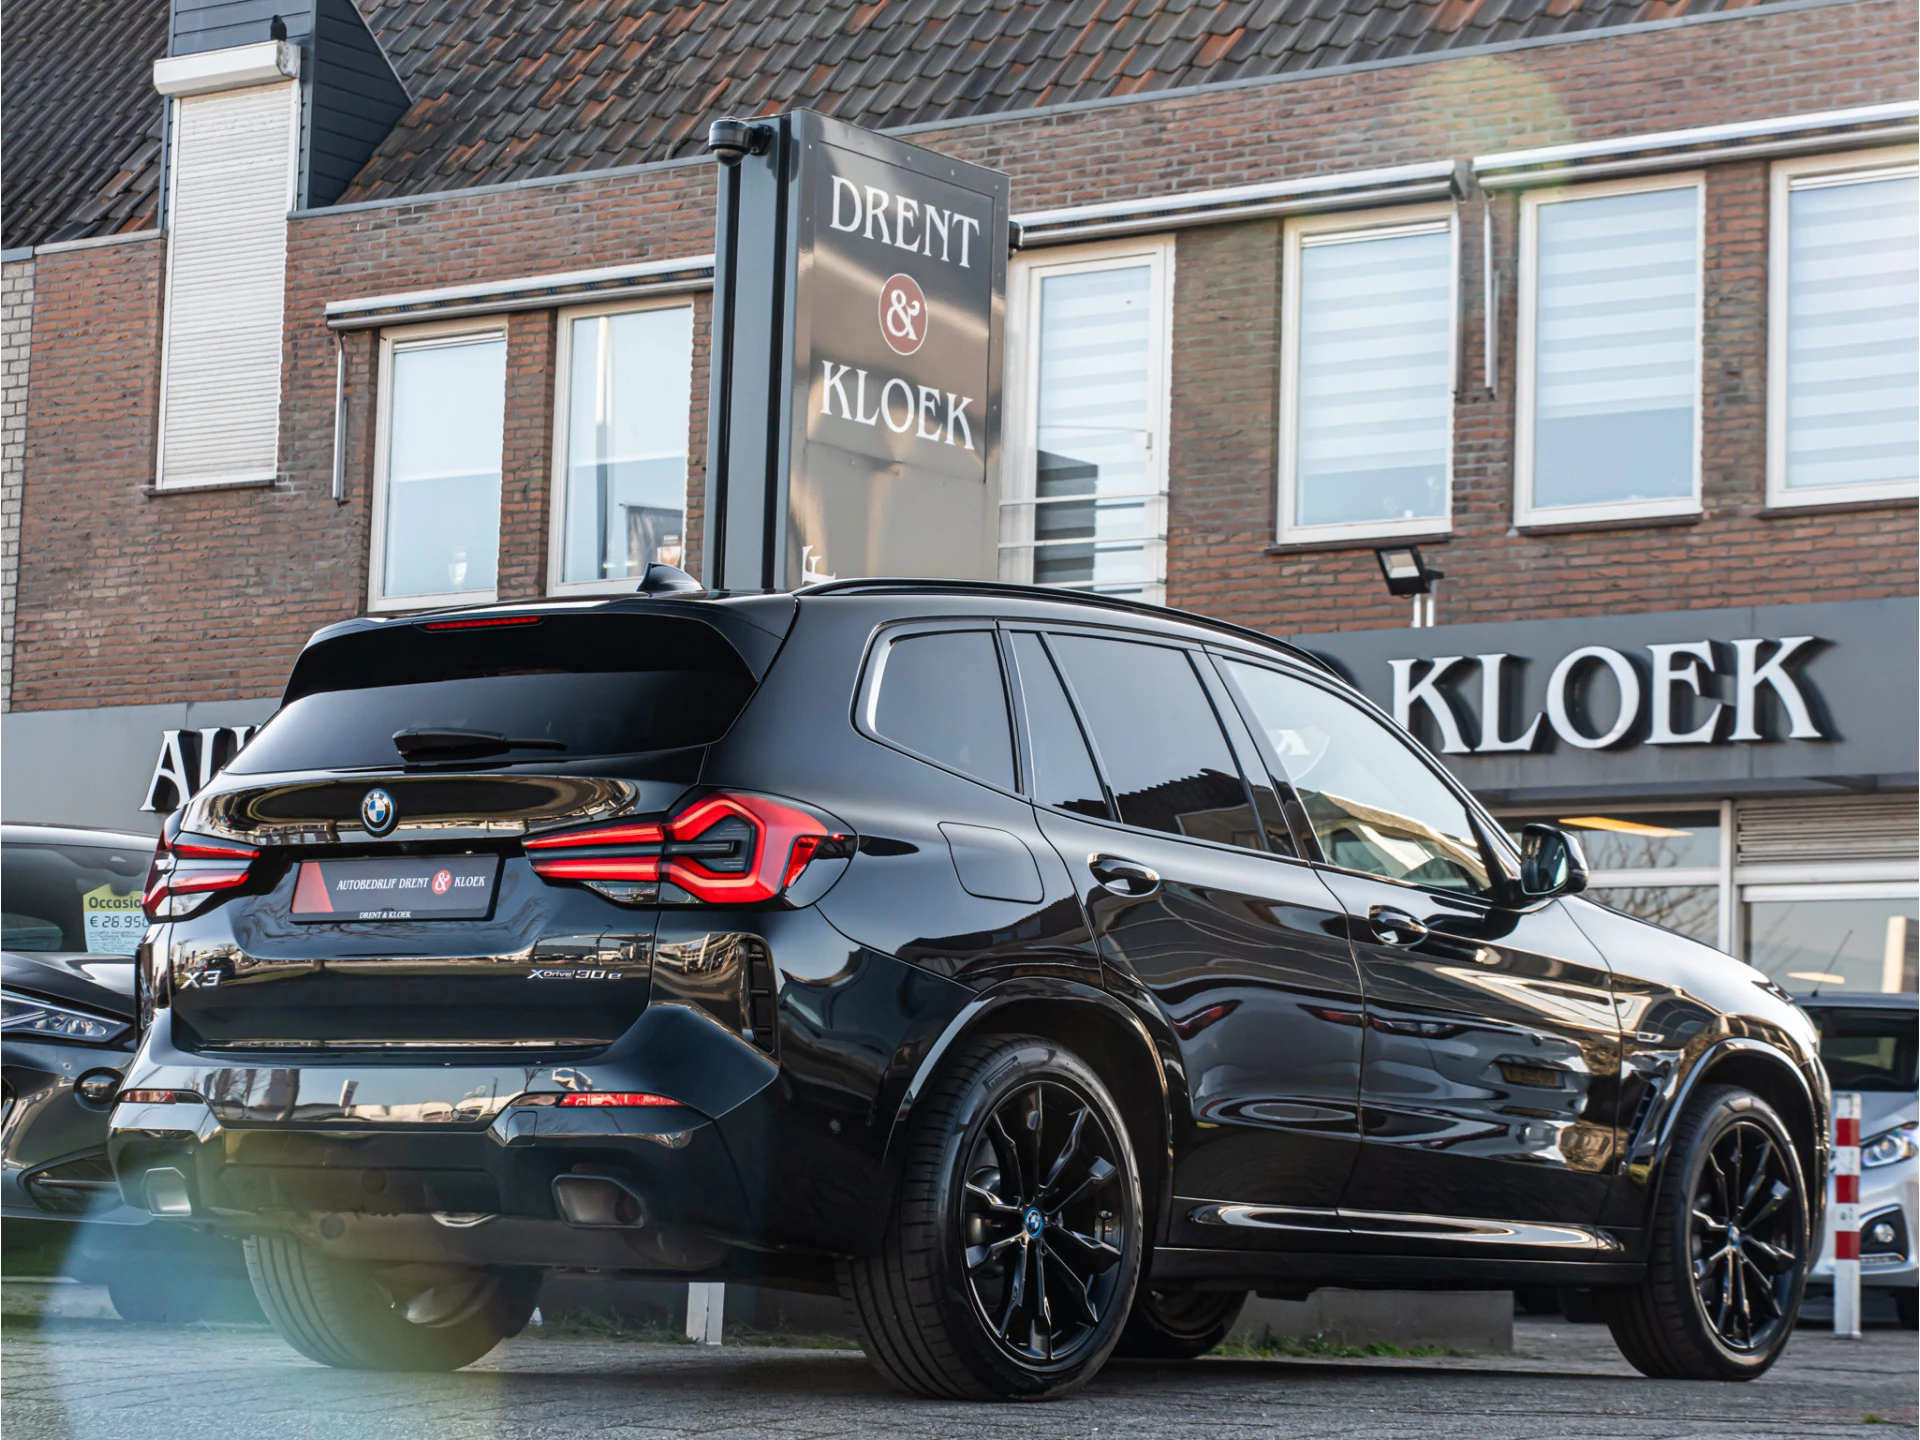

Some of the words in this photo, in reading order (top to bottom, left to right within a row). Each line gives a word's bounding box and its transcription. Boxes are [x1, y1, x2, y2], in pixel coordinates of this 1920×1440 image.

[830, 175, 980, 268] DRENT
[886, 289, 920, 341] &
[820, 360, 975, 450] KLOEK
[1388, 636, 1822, 753] KLOEK
[139, 724, 262, 811] AU
[336, 878, 396, 891] AUTOBEDRIJF
[399, 877, 429, 889] DRENT
[434, 872, 450, 891] &
[454, 876, 486, 887] KLOEK
[388, 910, 411, 918] KLOEK
[180, 970, 222, 989] X3
